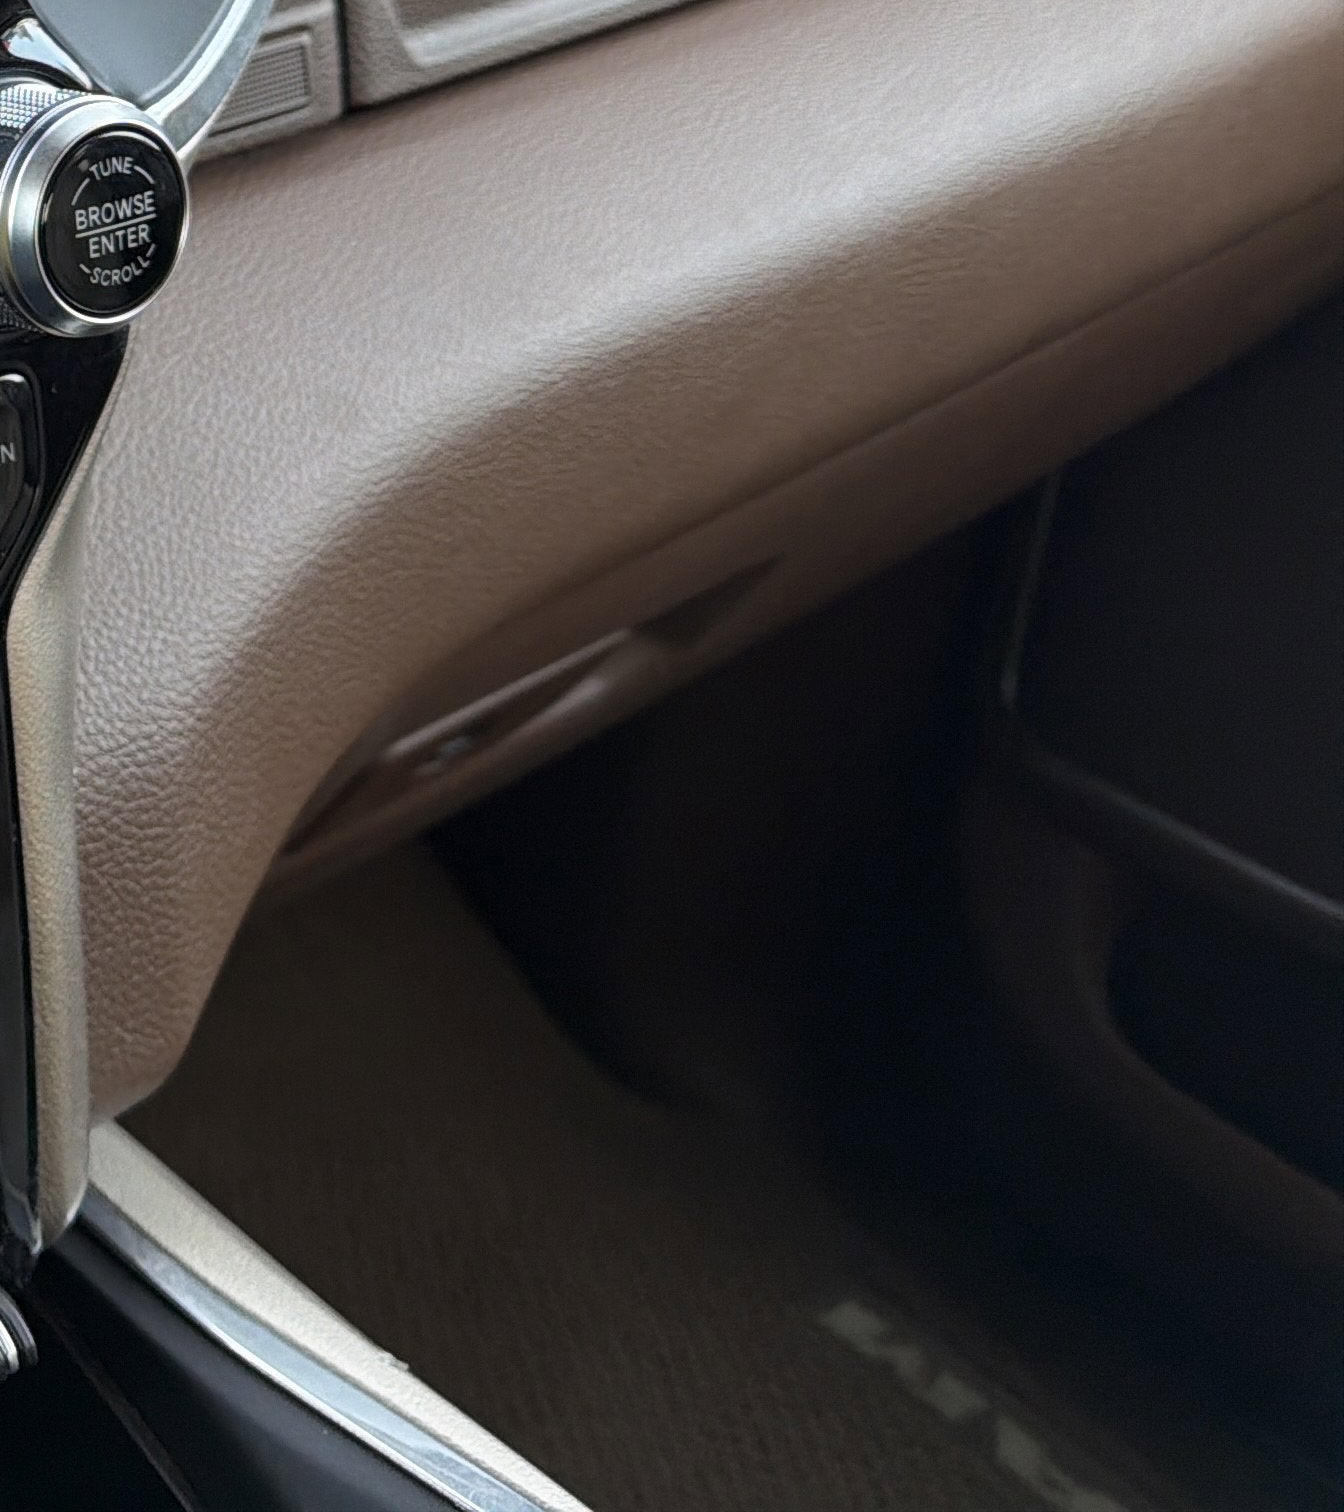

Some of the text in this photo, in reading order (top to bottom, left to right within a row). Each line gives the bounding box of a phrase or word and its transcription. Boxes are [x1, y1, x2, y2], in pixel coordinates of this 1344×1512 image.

[89, 157, 134, 182] TUNE
[75, 190, 156, 231] BROWSE
[88, 224, 151, 260] ENTER
[89, 255, 151, 287] SCROLL
